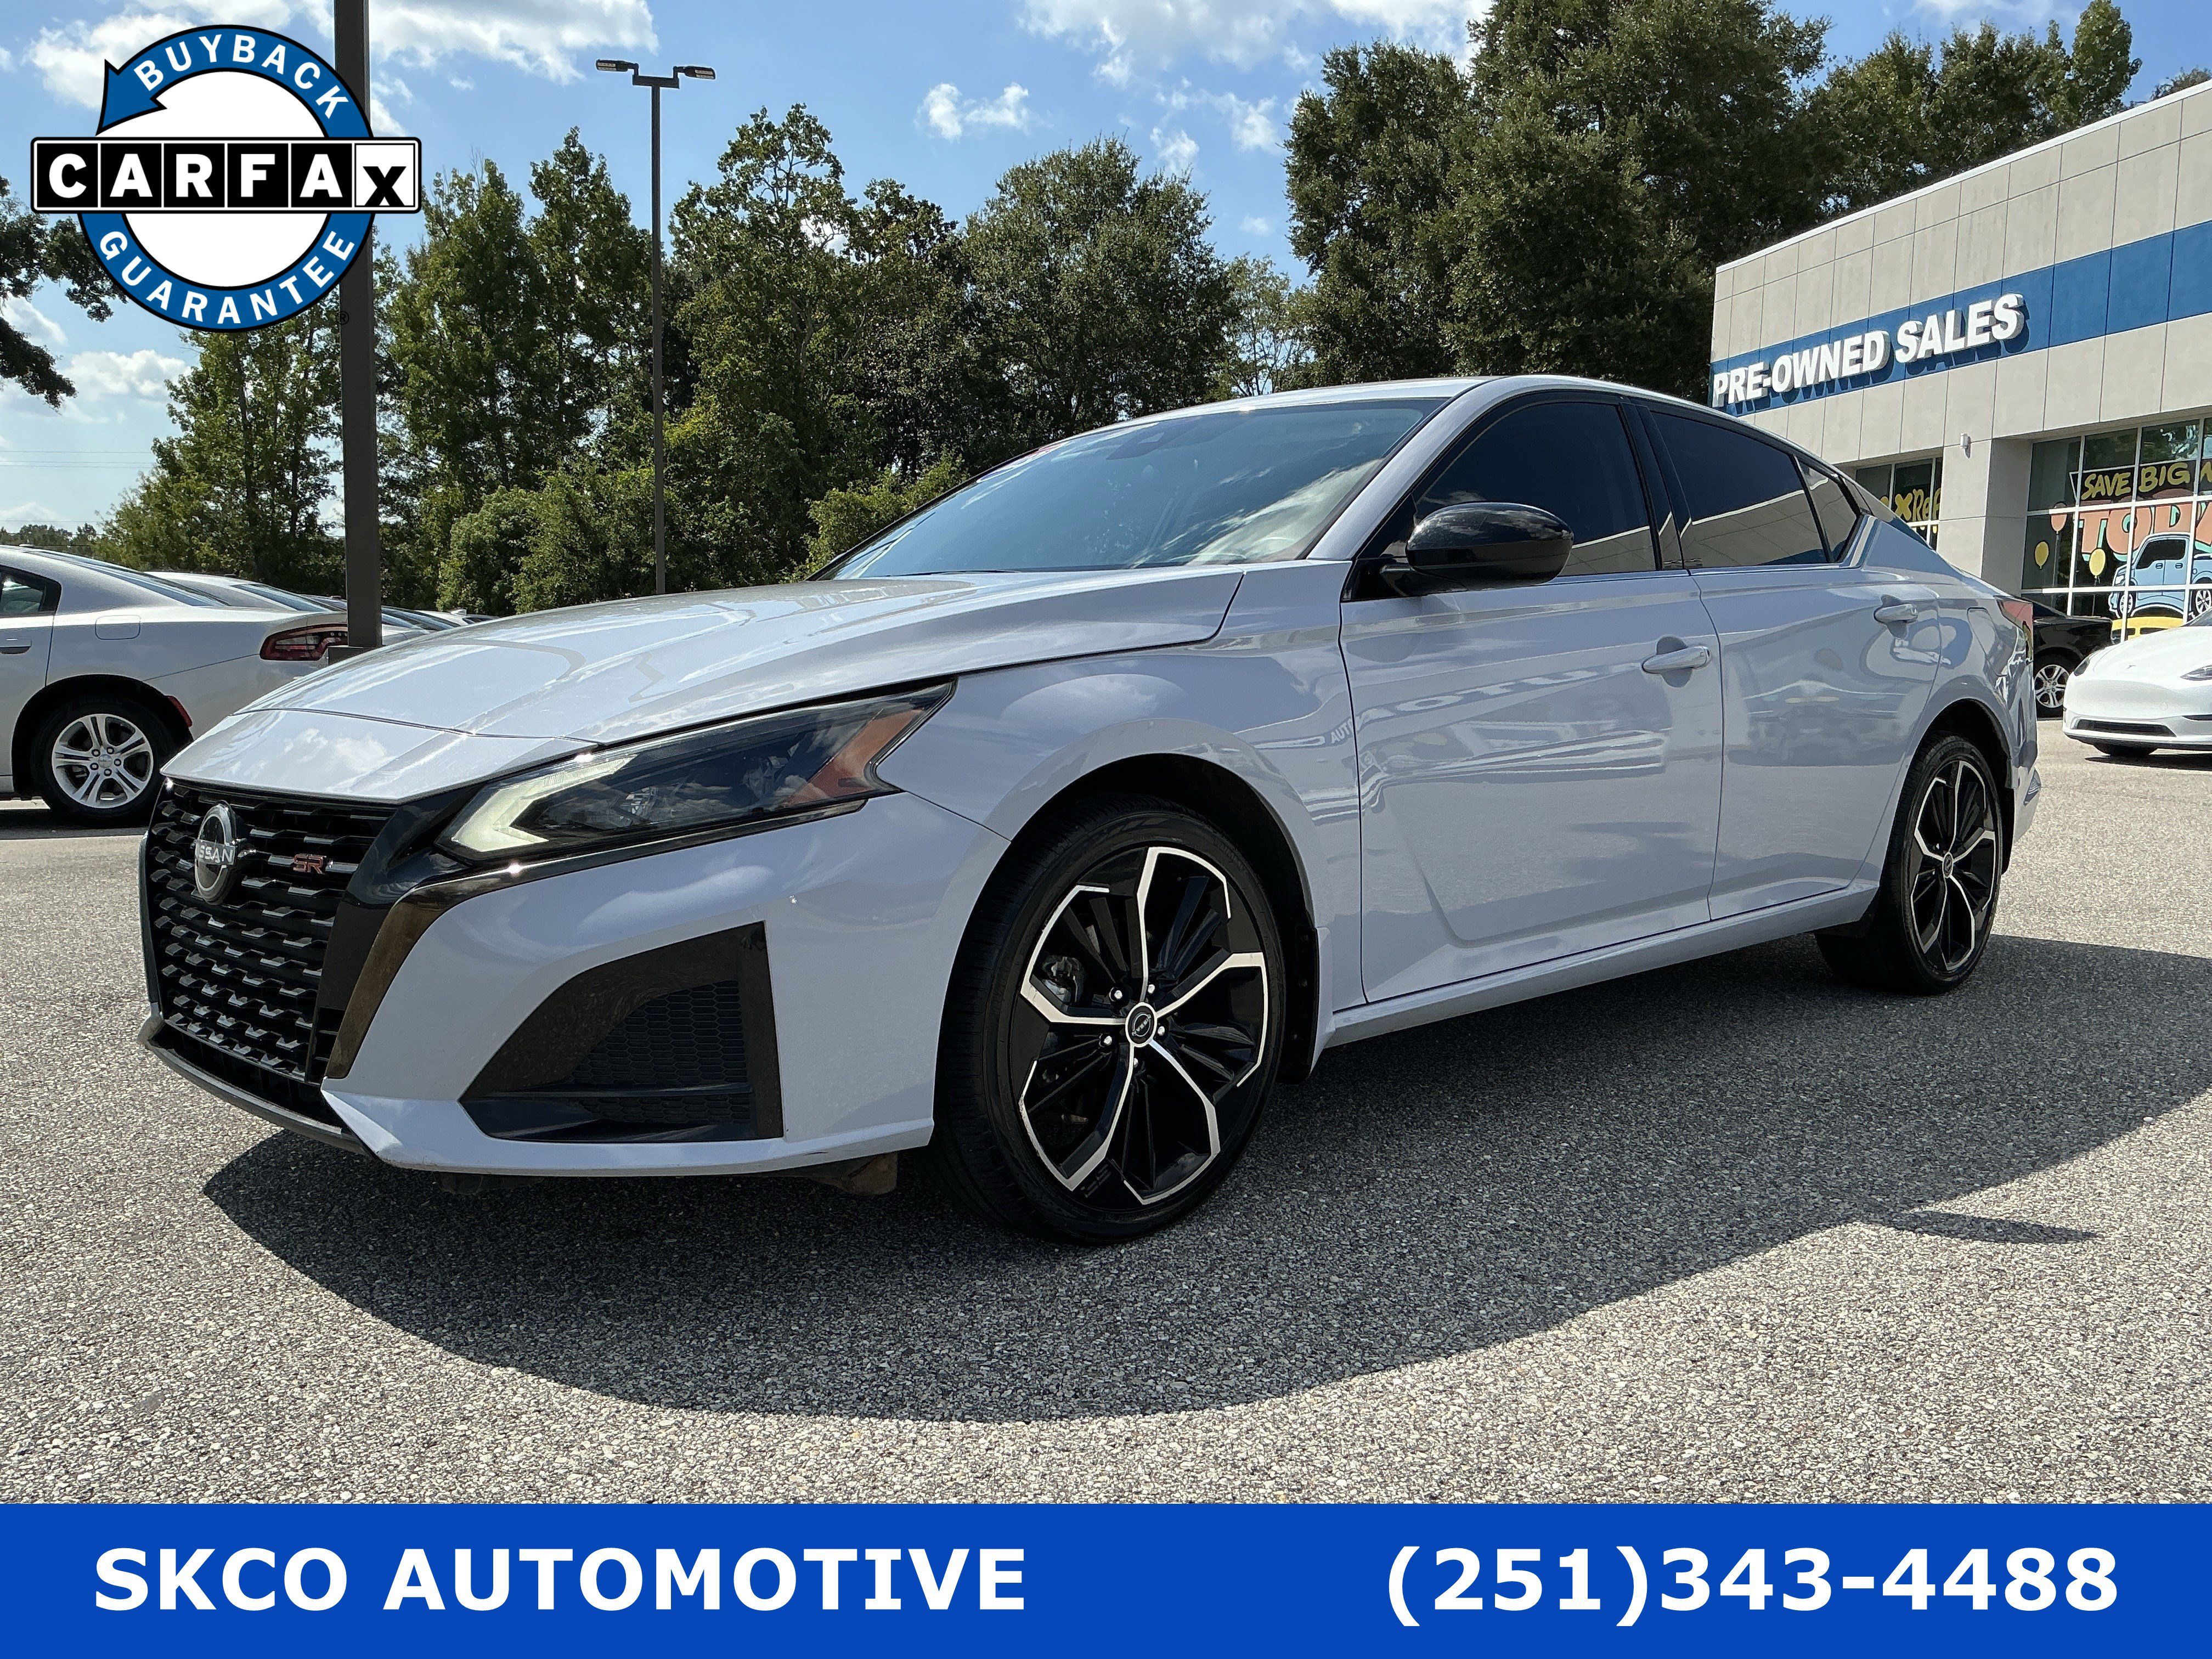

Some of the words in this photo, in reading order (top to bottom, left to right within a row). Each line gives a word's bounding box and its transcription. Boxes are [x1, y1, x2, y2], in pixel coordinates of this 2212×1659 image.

[1712, 330, 1889, 408] PRE-OWNED
[1894, 293, 2025, 364] SALES
[2081, 472, 2131, 500] SAVE
[2138, 462, 2191, 493] BIG
[293, 854, 327, 874] SR
